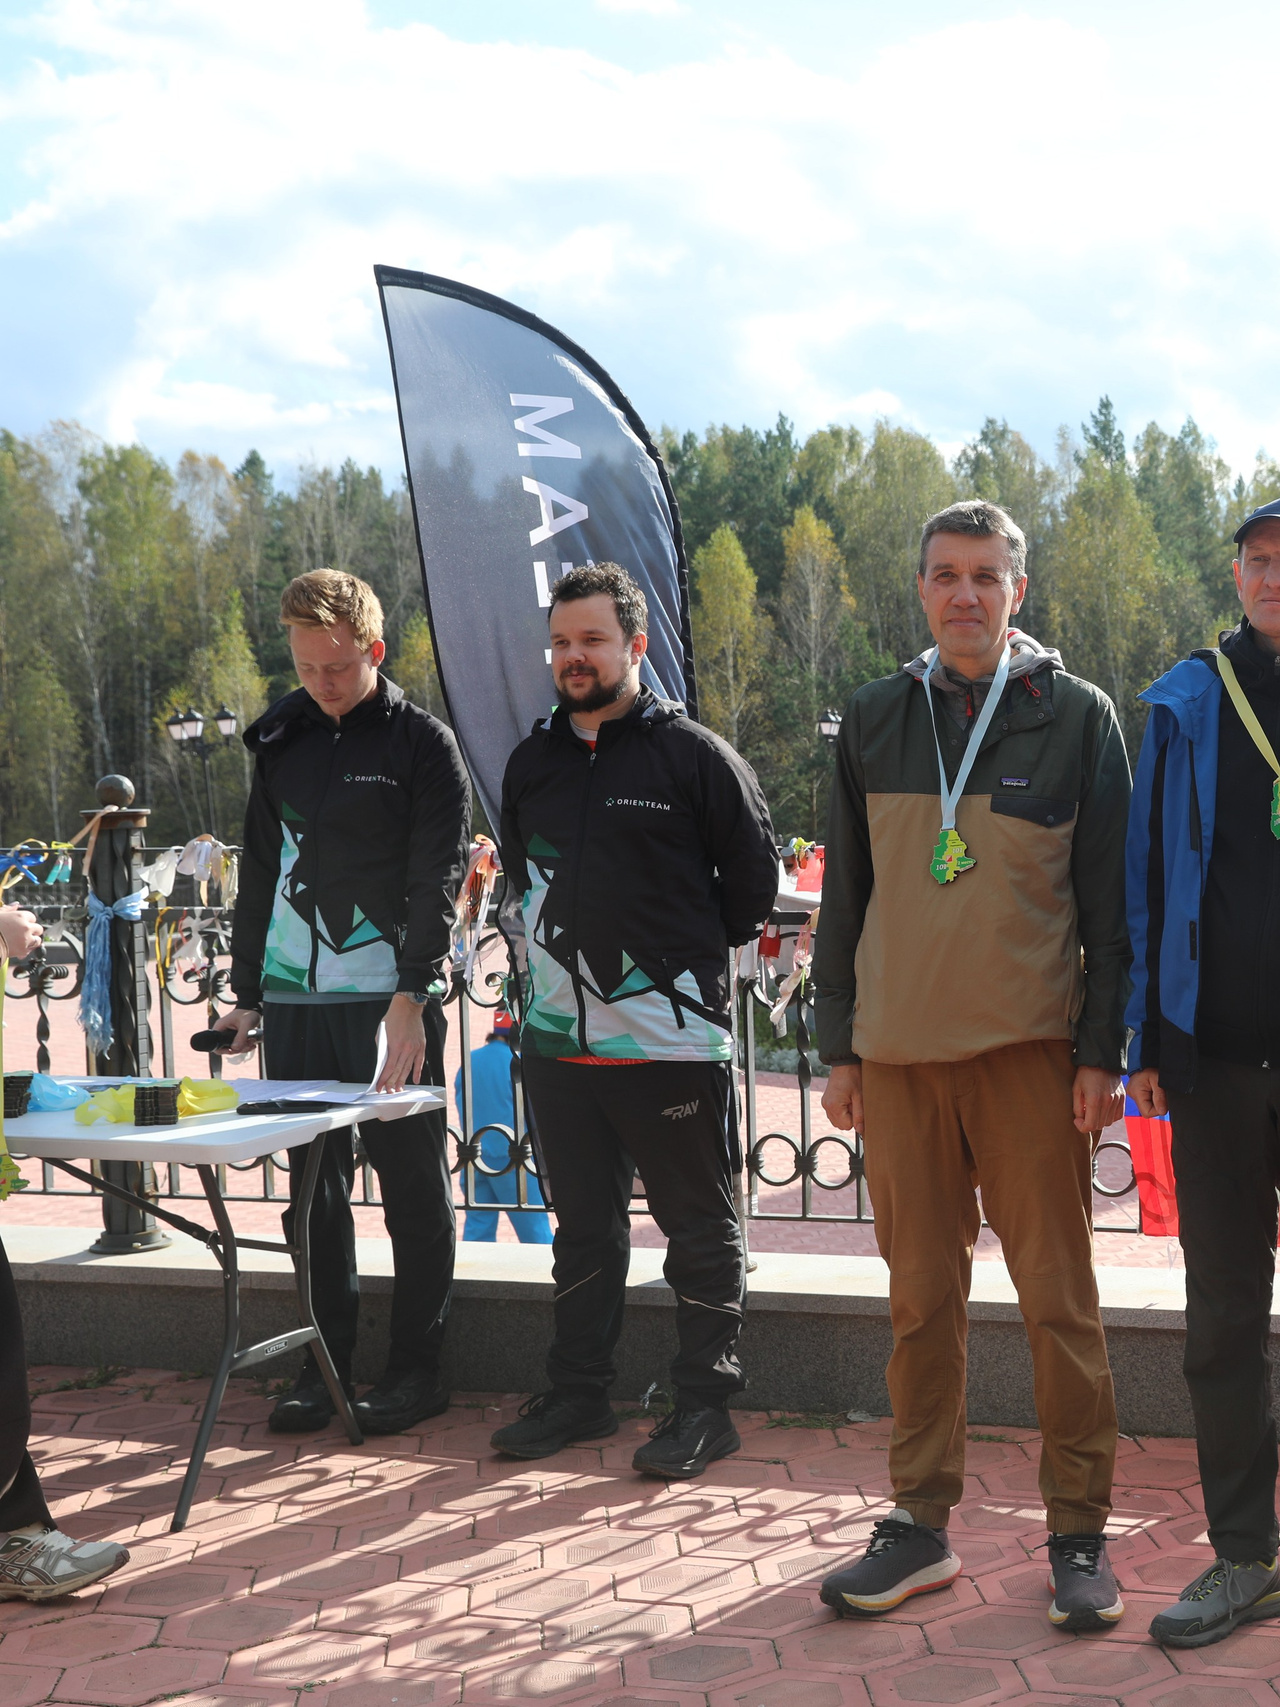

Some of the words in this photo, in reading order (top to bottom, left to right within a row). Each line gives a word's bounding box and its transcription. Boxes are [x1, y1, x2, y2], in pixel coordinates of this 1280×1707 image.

[355, 774, 398, 786] ORIENTEAM
[616, 798, 671, 811] ORIENTEAM
[661, 1099, 699, 1120] RAY
